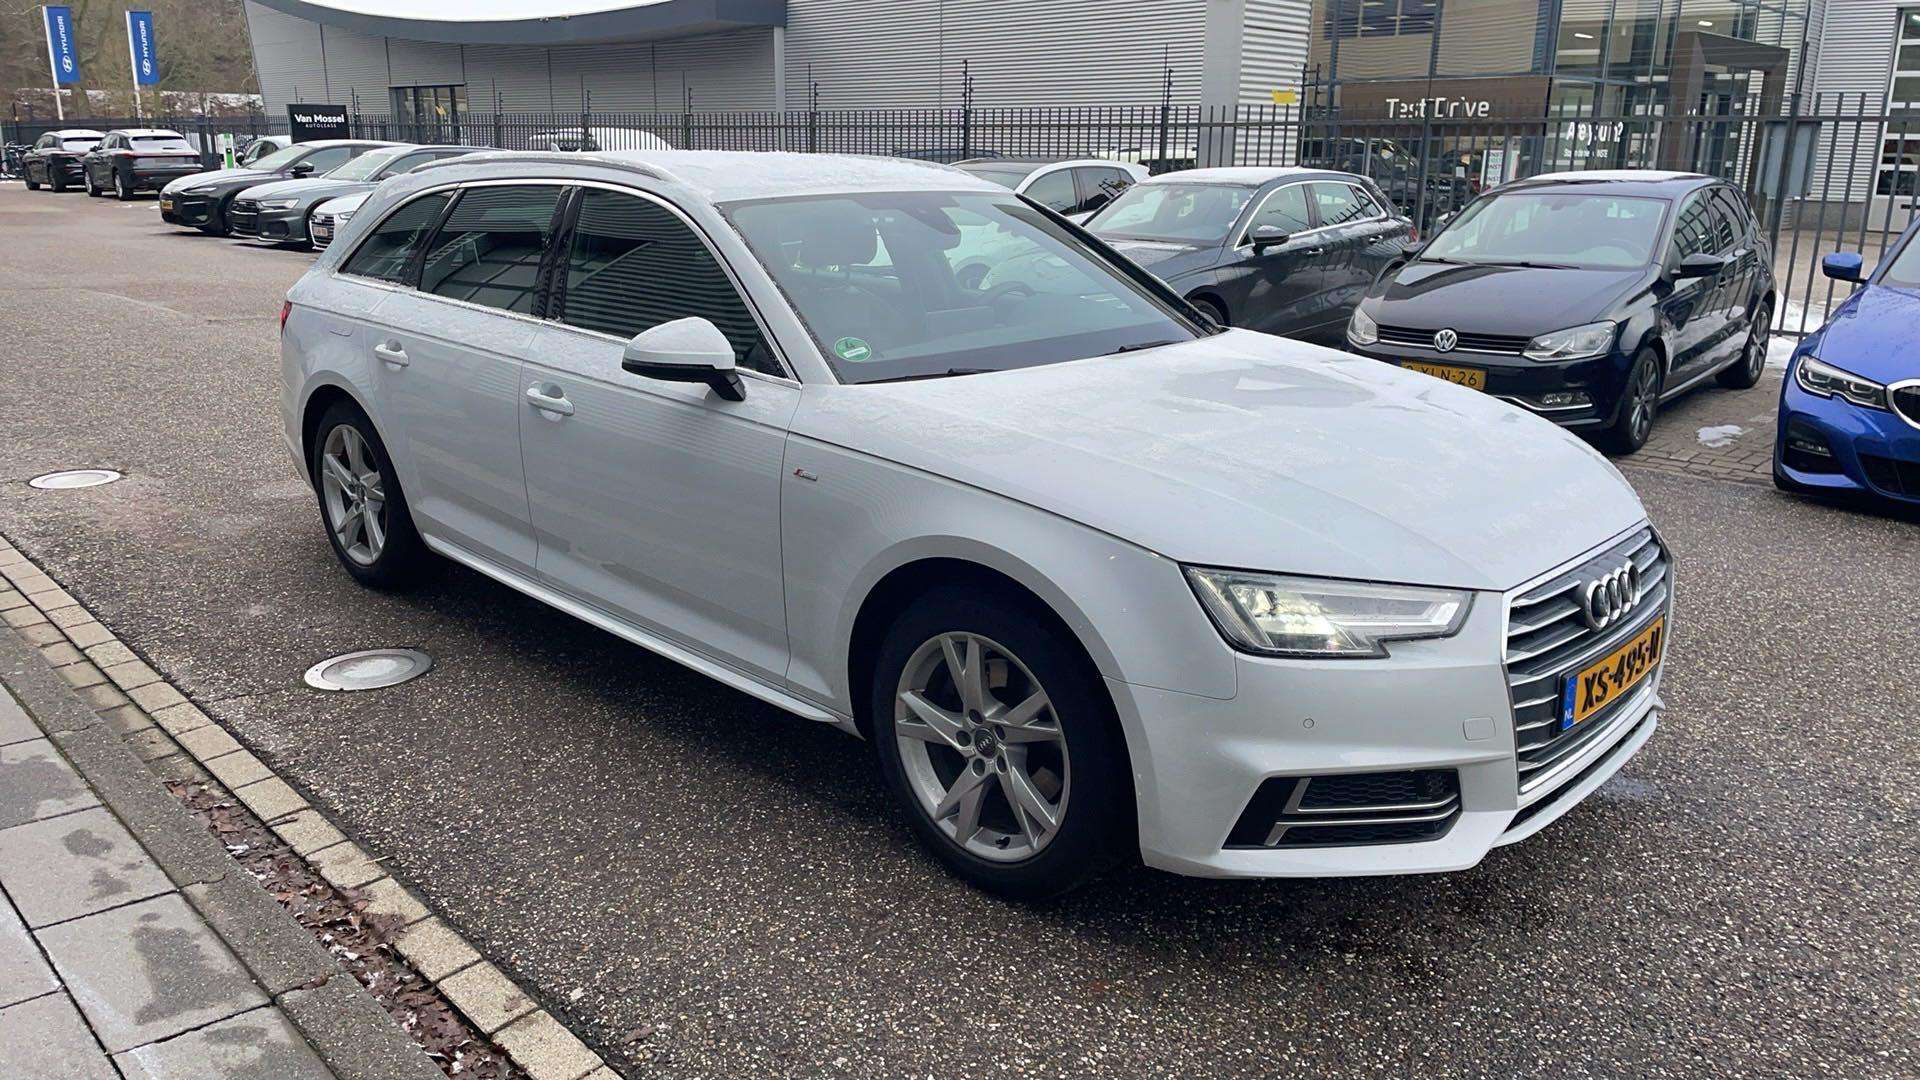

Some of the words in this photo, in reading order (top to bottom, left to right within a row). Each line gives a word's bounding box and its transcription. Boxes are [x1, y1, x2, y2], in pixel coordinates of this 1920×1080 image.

[57, 15, 69, 54] HYUNDAI
[139, 20, 149, 58] HYUNDAI
[294, 113, 312, 123] Van
[313, 113, 345, 123] Mossel
[1564, 710, 1573, 722] NL
